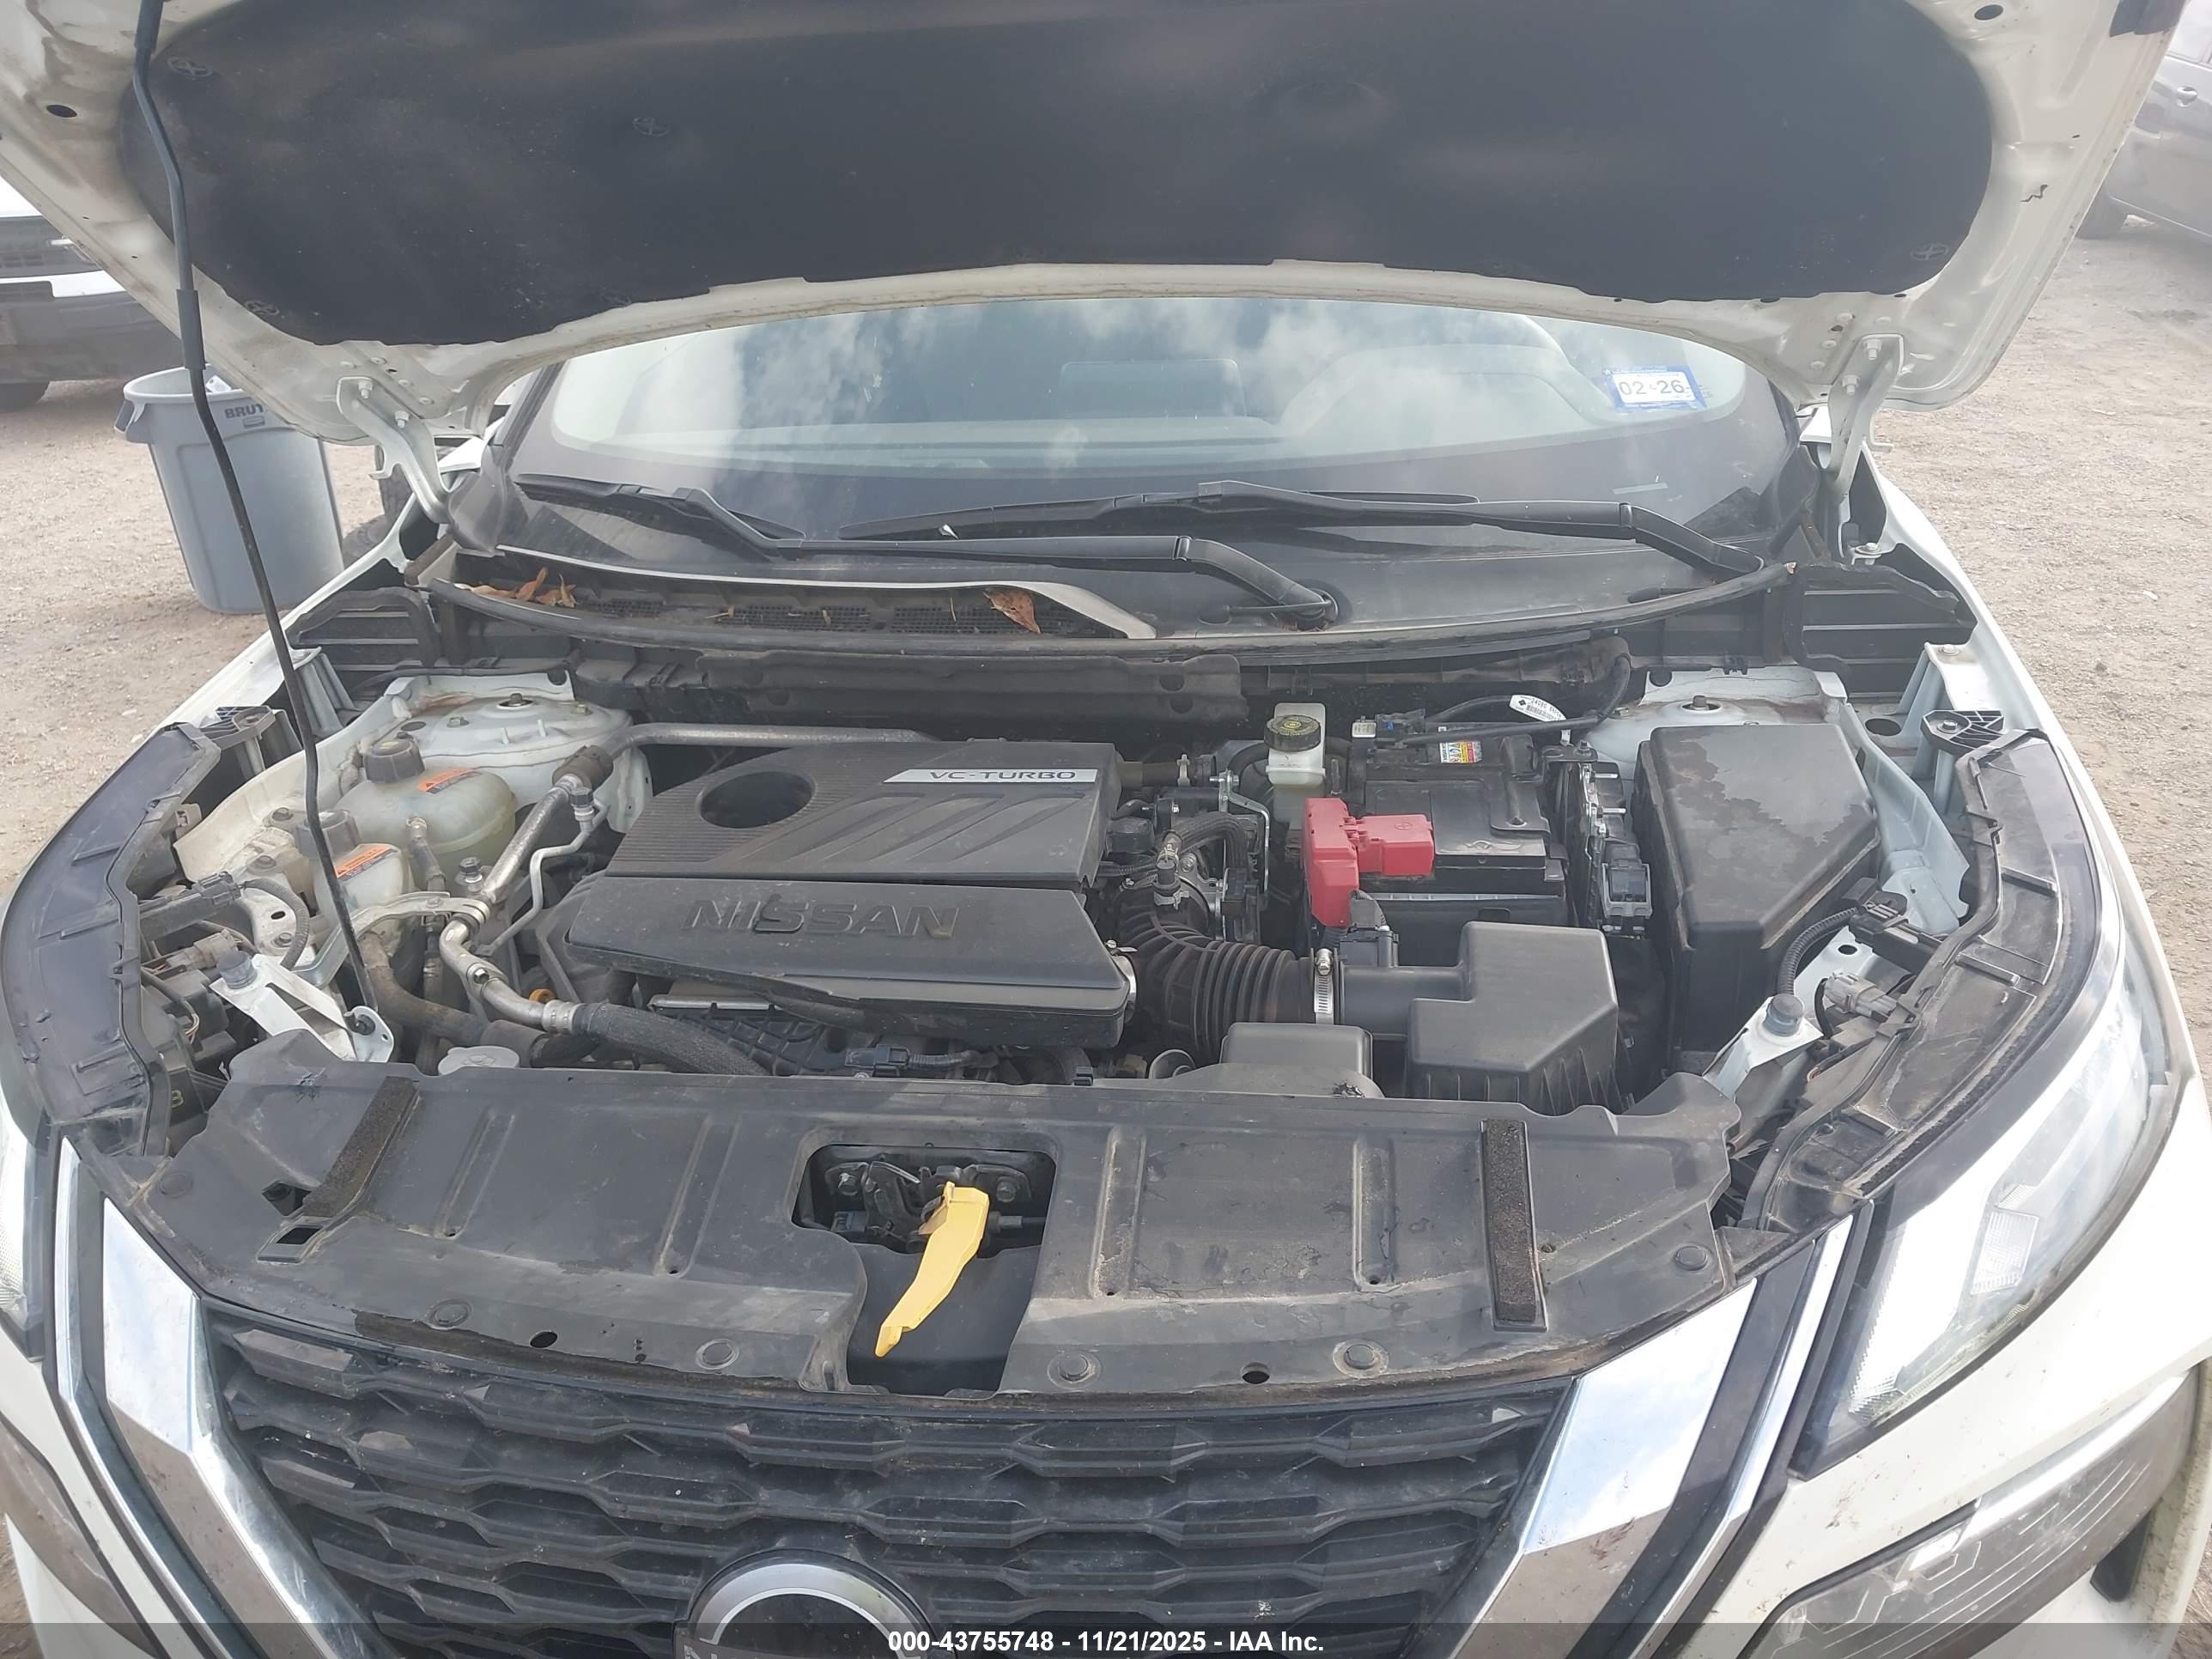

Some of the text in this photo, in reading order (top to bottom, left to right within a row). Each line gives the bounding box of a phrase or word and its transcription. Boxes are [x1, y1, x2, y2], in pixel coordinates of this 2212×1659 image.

[1619, 381, 1647, 395] 02
[1656, 380, 1685, 393] 26
[930, 771, 1076, 780] VC-TURBO
[684, 900, 959, 938] NISSAN
